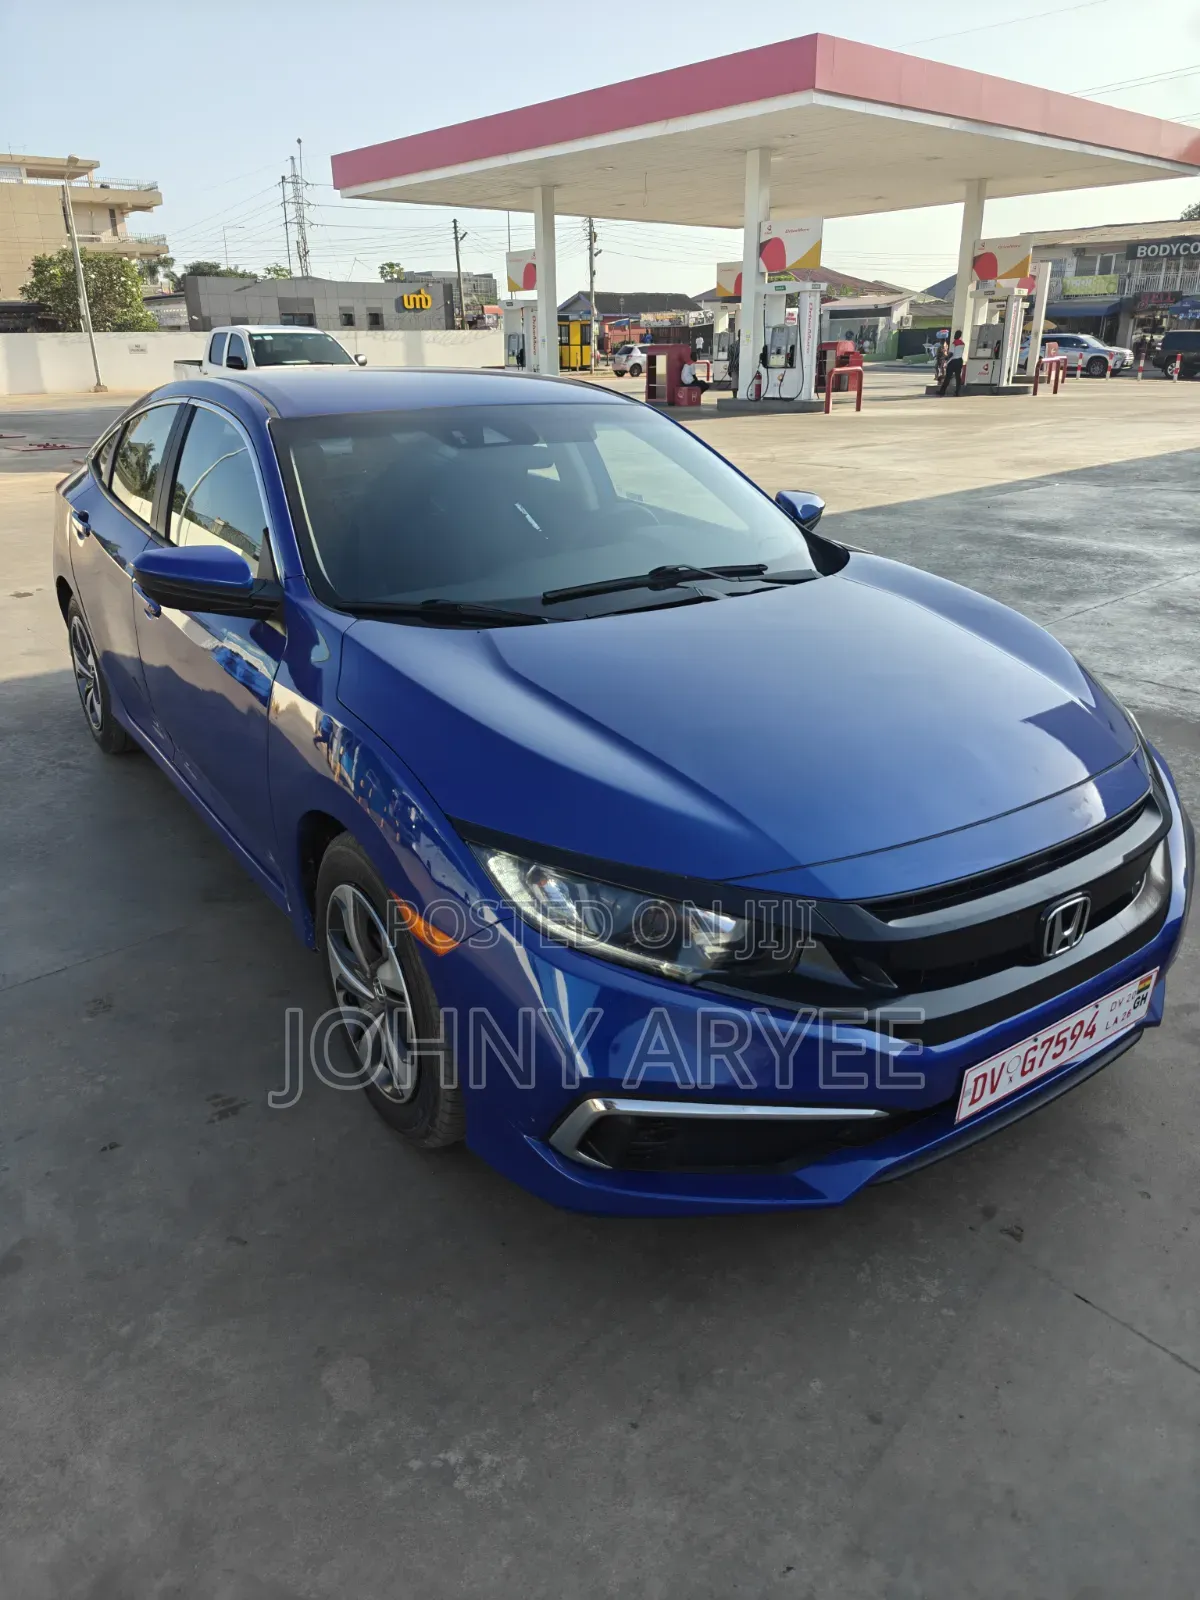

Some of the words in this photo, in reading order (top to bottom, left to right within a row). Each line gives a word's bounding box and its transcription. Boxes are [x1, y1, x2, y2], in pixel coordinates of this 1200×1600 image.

[1136, 241, 1200, 258] BODYCO
[1133, 992, 1149, 1010] GH
[968, 1061, 1005, 1107] DV
[1020, 1010, 1099, 1078] G7594
